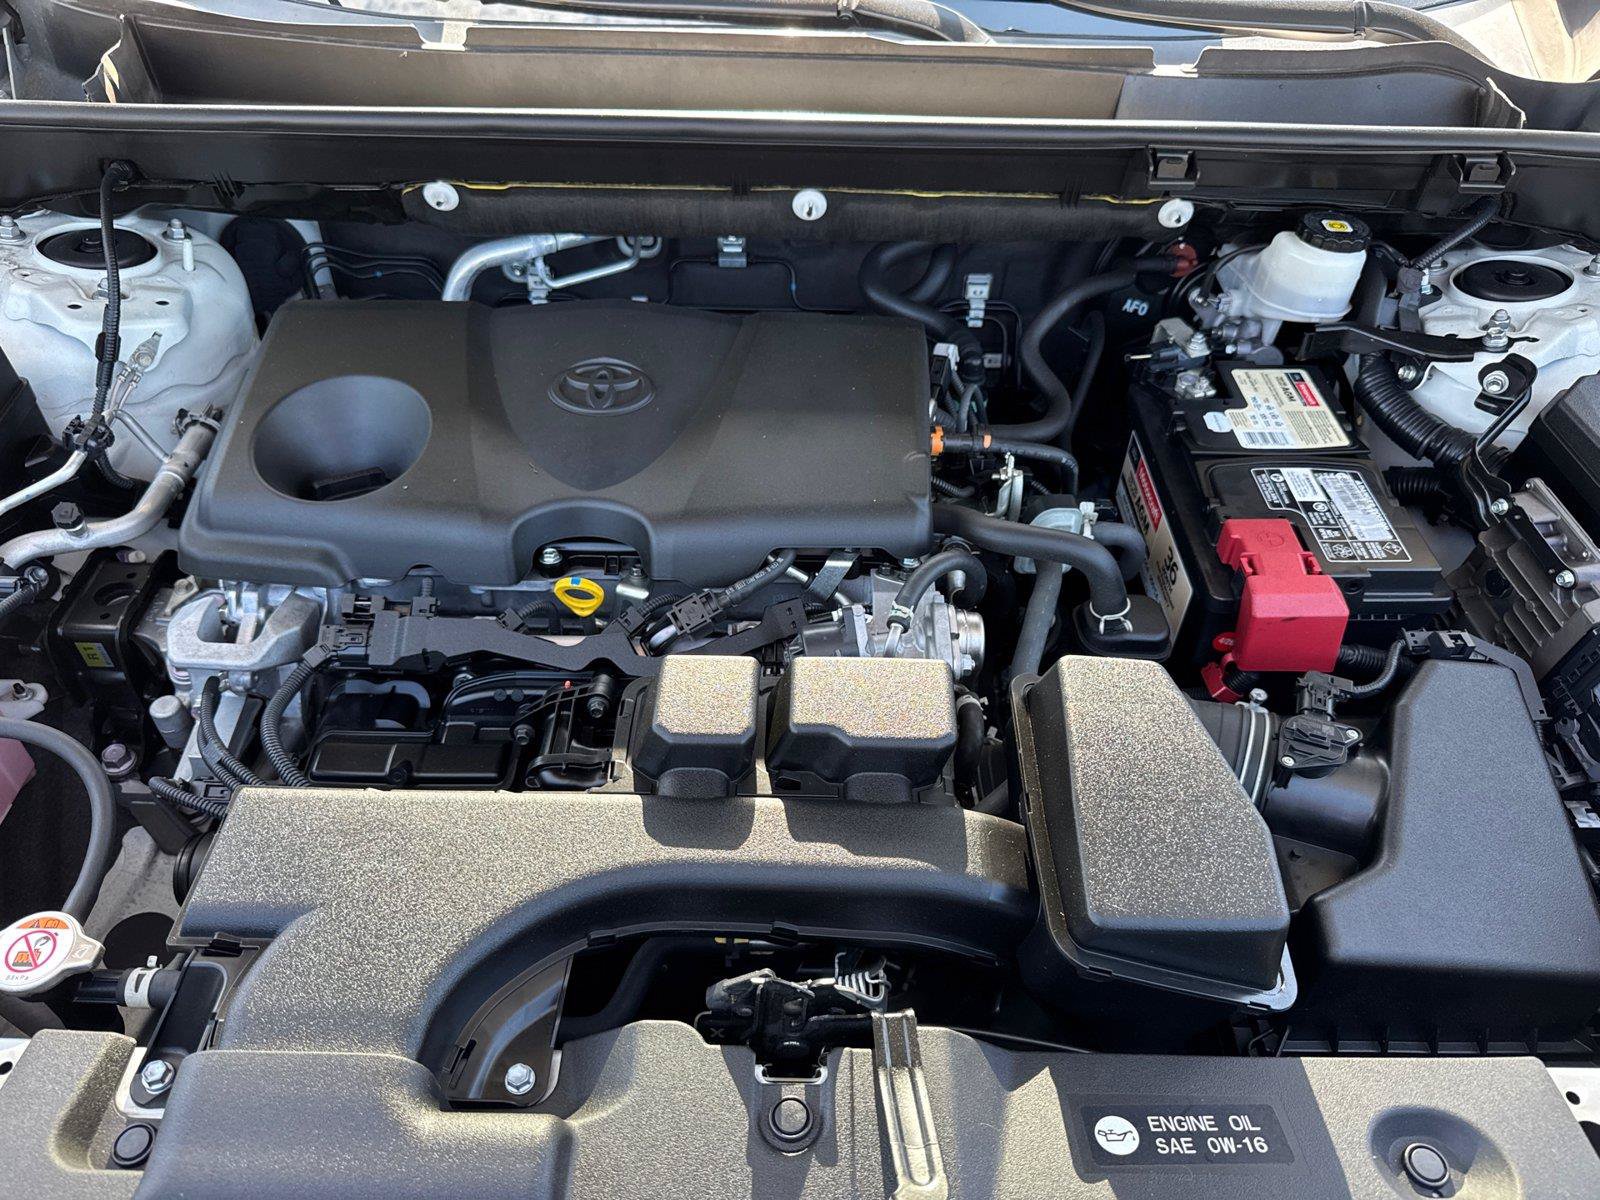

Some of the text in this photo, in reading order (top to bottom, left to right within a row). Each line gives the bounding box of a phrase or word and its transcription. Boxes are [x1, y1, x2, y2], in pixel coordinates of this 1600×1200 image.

[1282, 387, 1296, 402] AGM
[1164, 545, 1178, 586] 36
[1147, 1115, 1261, 1132] ENGINE OIL
[1156, 1137, 1269, 1155] SAE 0W-16
